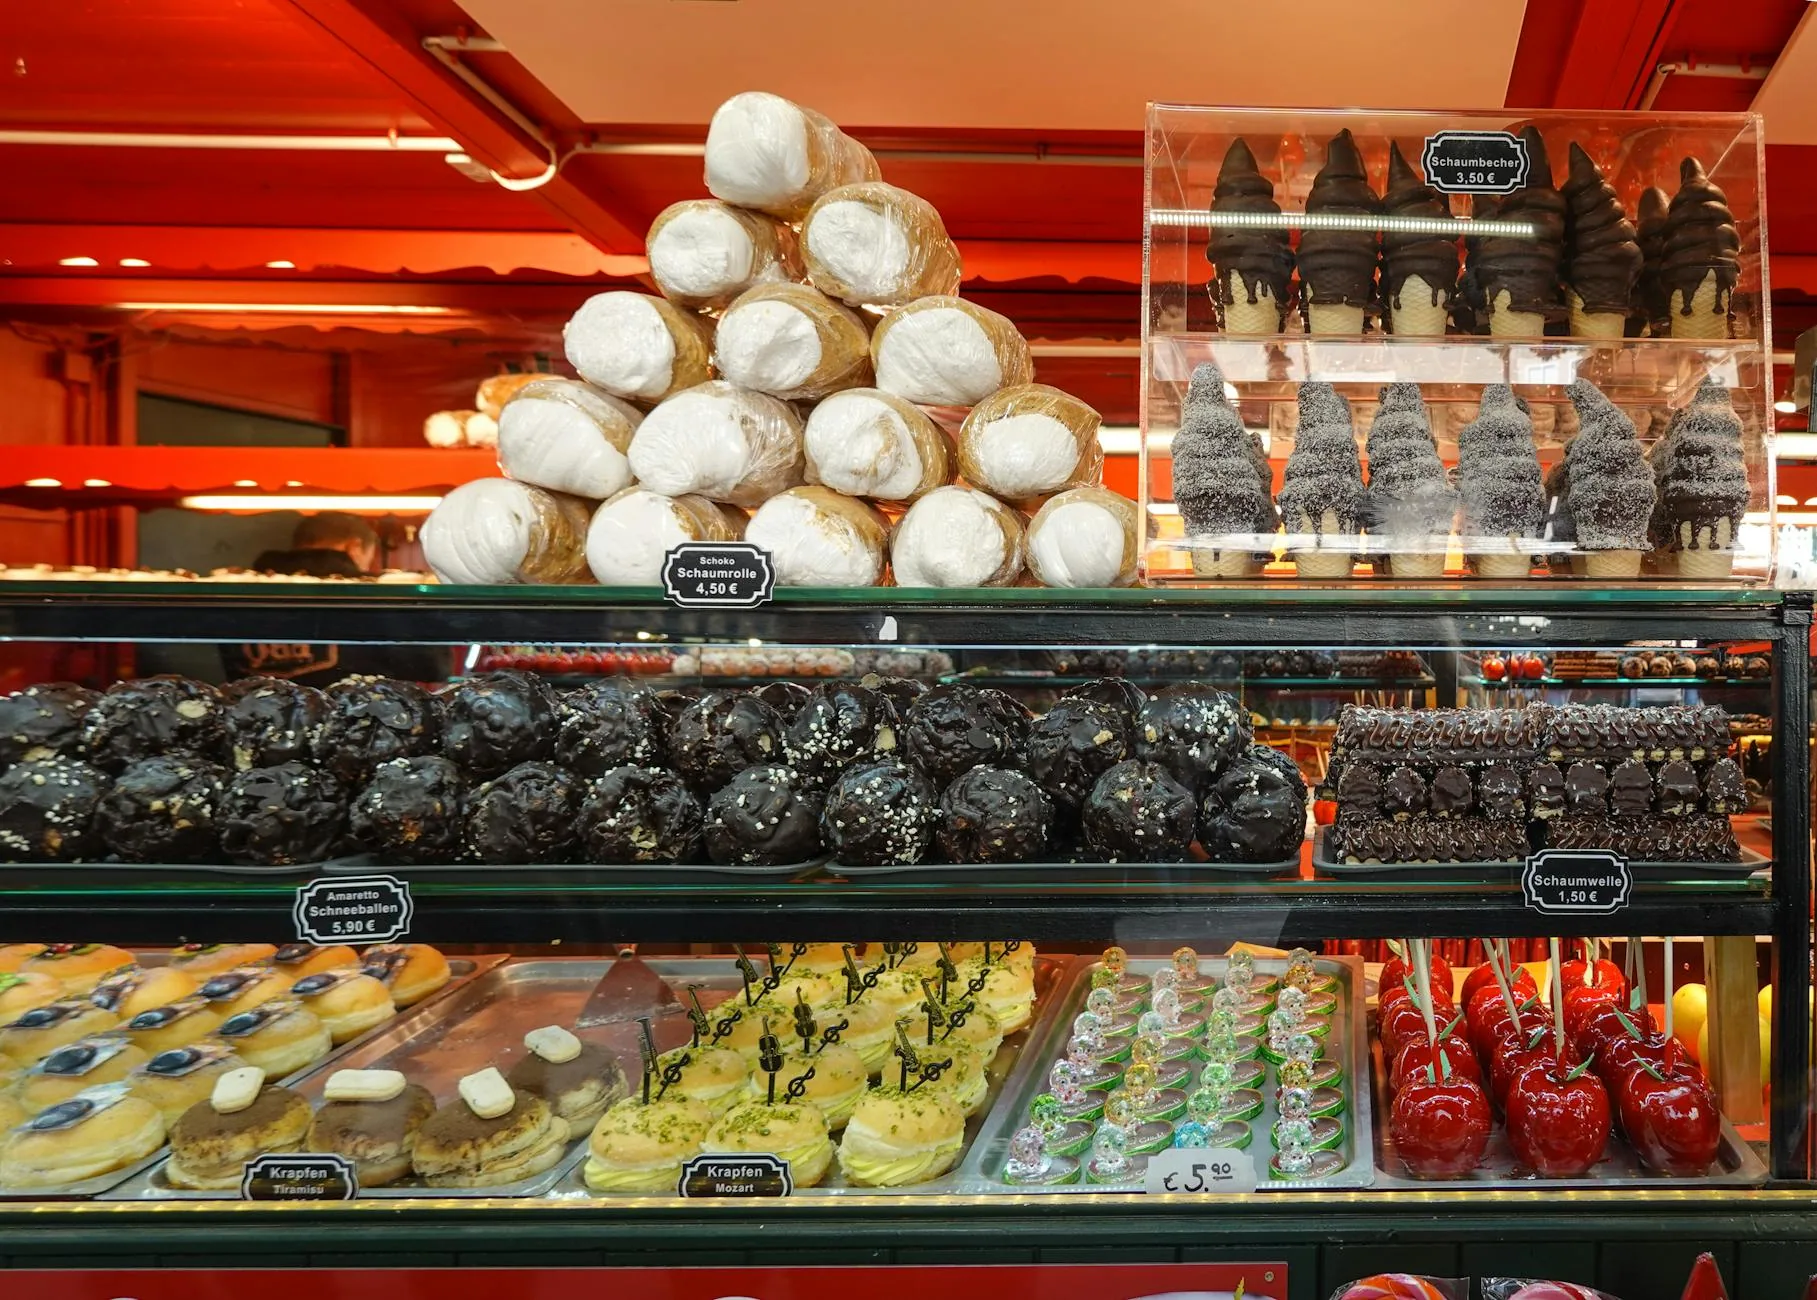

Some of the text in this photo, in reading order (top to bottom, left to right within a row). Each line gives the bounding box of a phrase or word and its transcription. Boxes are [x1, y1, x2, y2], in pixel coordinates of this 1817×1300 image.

[1431, 156, 1520, 168] Schaumbecher
[1456, 171, 1496, 185] 3,50 €
[699, 556, 736, 566] Schoko
[677, 567, 757, 579] Schaumrolle
[695, 582, 739, 596] 4,50 €
[1534, 874, 1623, 887] Schaumwelle
[326, 890, 380, 902] Amaretto
[1558, 890, 1599, 904] 1,50 €
[309, 903, 399, 917] Schneeballen
[332, 919, 376, 935] 5,90 €
[269, 1166, 328, 1181] Krapfen
[707, 1165, 763, 1180] Krapfen
[715, 1183, 755, 1193] Mozart
[1163, 1171, 1179, 1192] €
